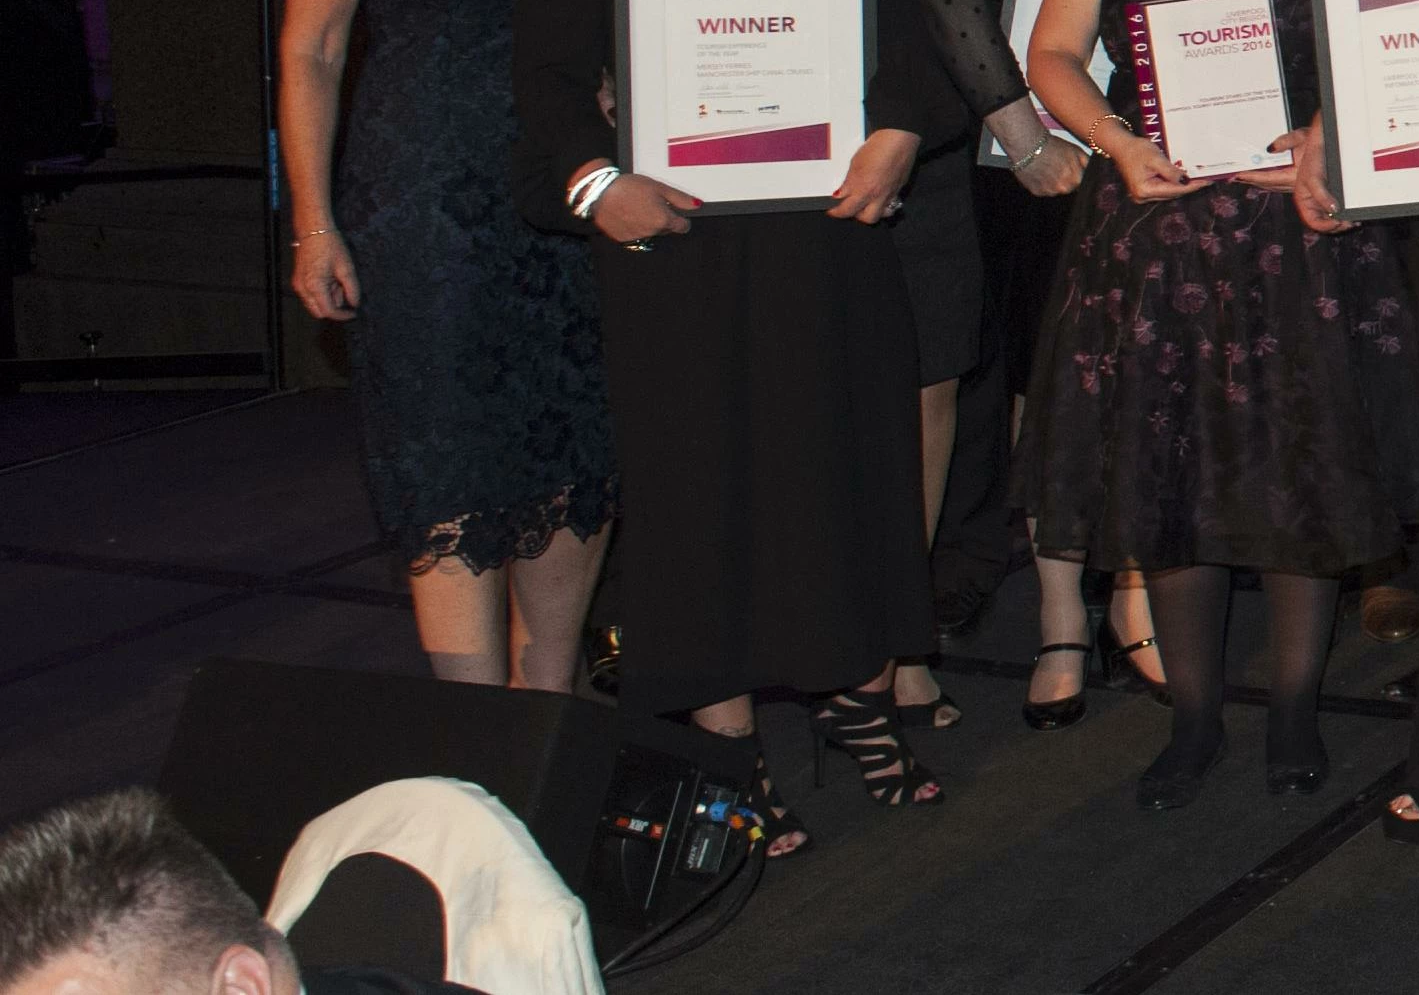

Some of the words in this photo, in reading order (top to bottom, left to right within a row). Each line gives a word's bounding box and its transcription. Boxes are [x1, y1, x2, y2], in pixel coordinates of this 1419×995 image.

[697, 16, 796, 35] WINNER
[1178, 23, 1271, 47] TOURISM
[1130, 14, 1150, 66] 2016
[1184, 43, 1239, 59] AWARDS
[1242, 39, 1272, 52] 2016
[1140, 83, 1162, 143] NNER
